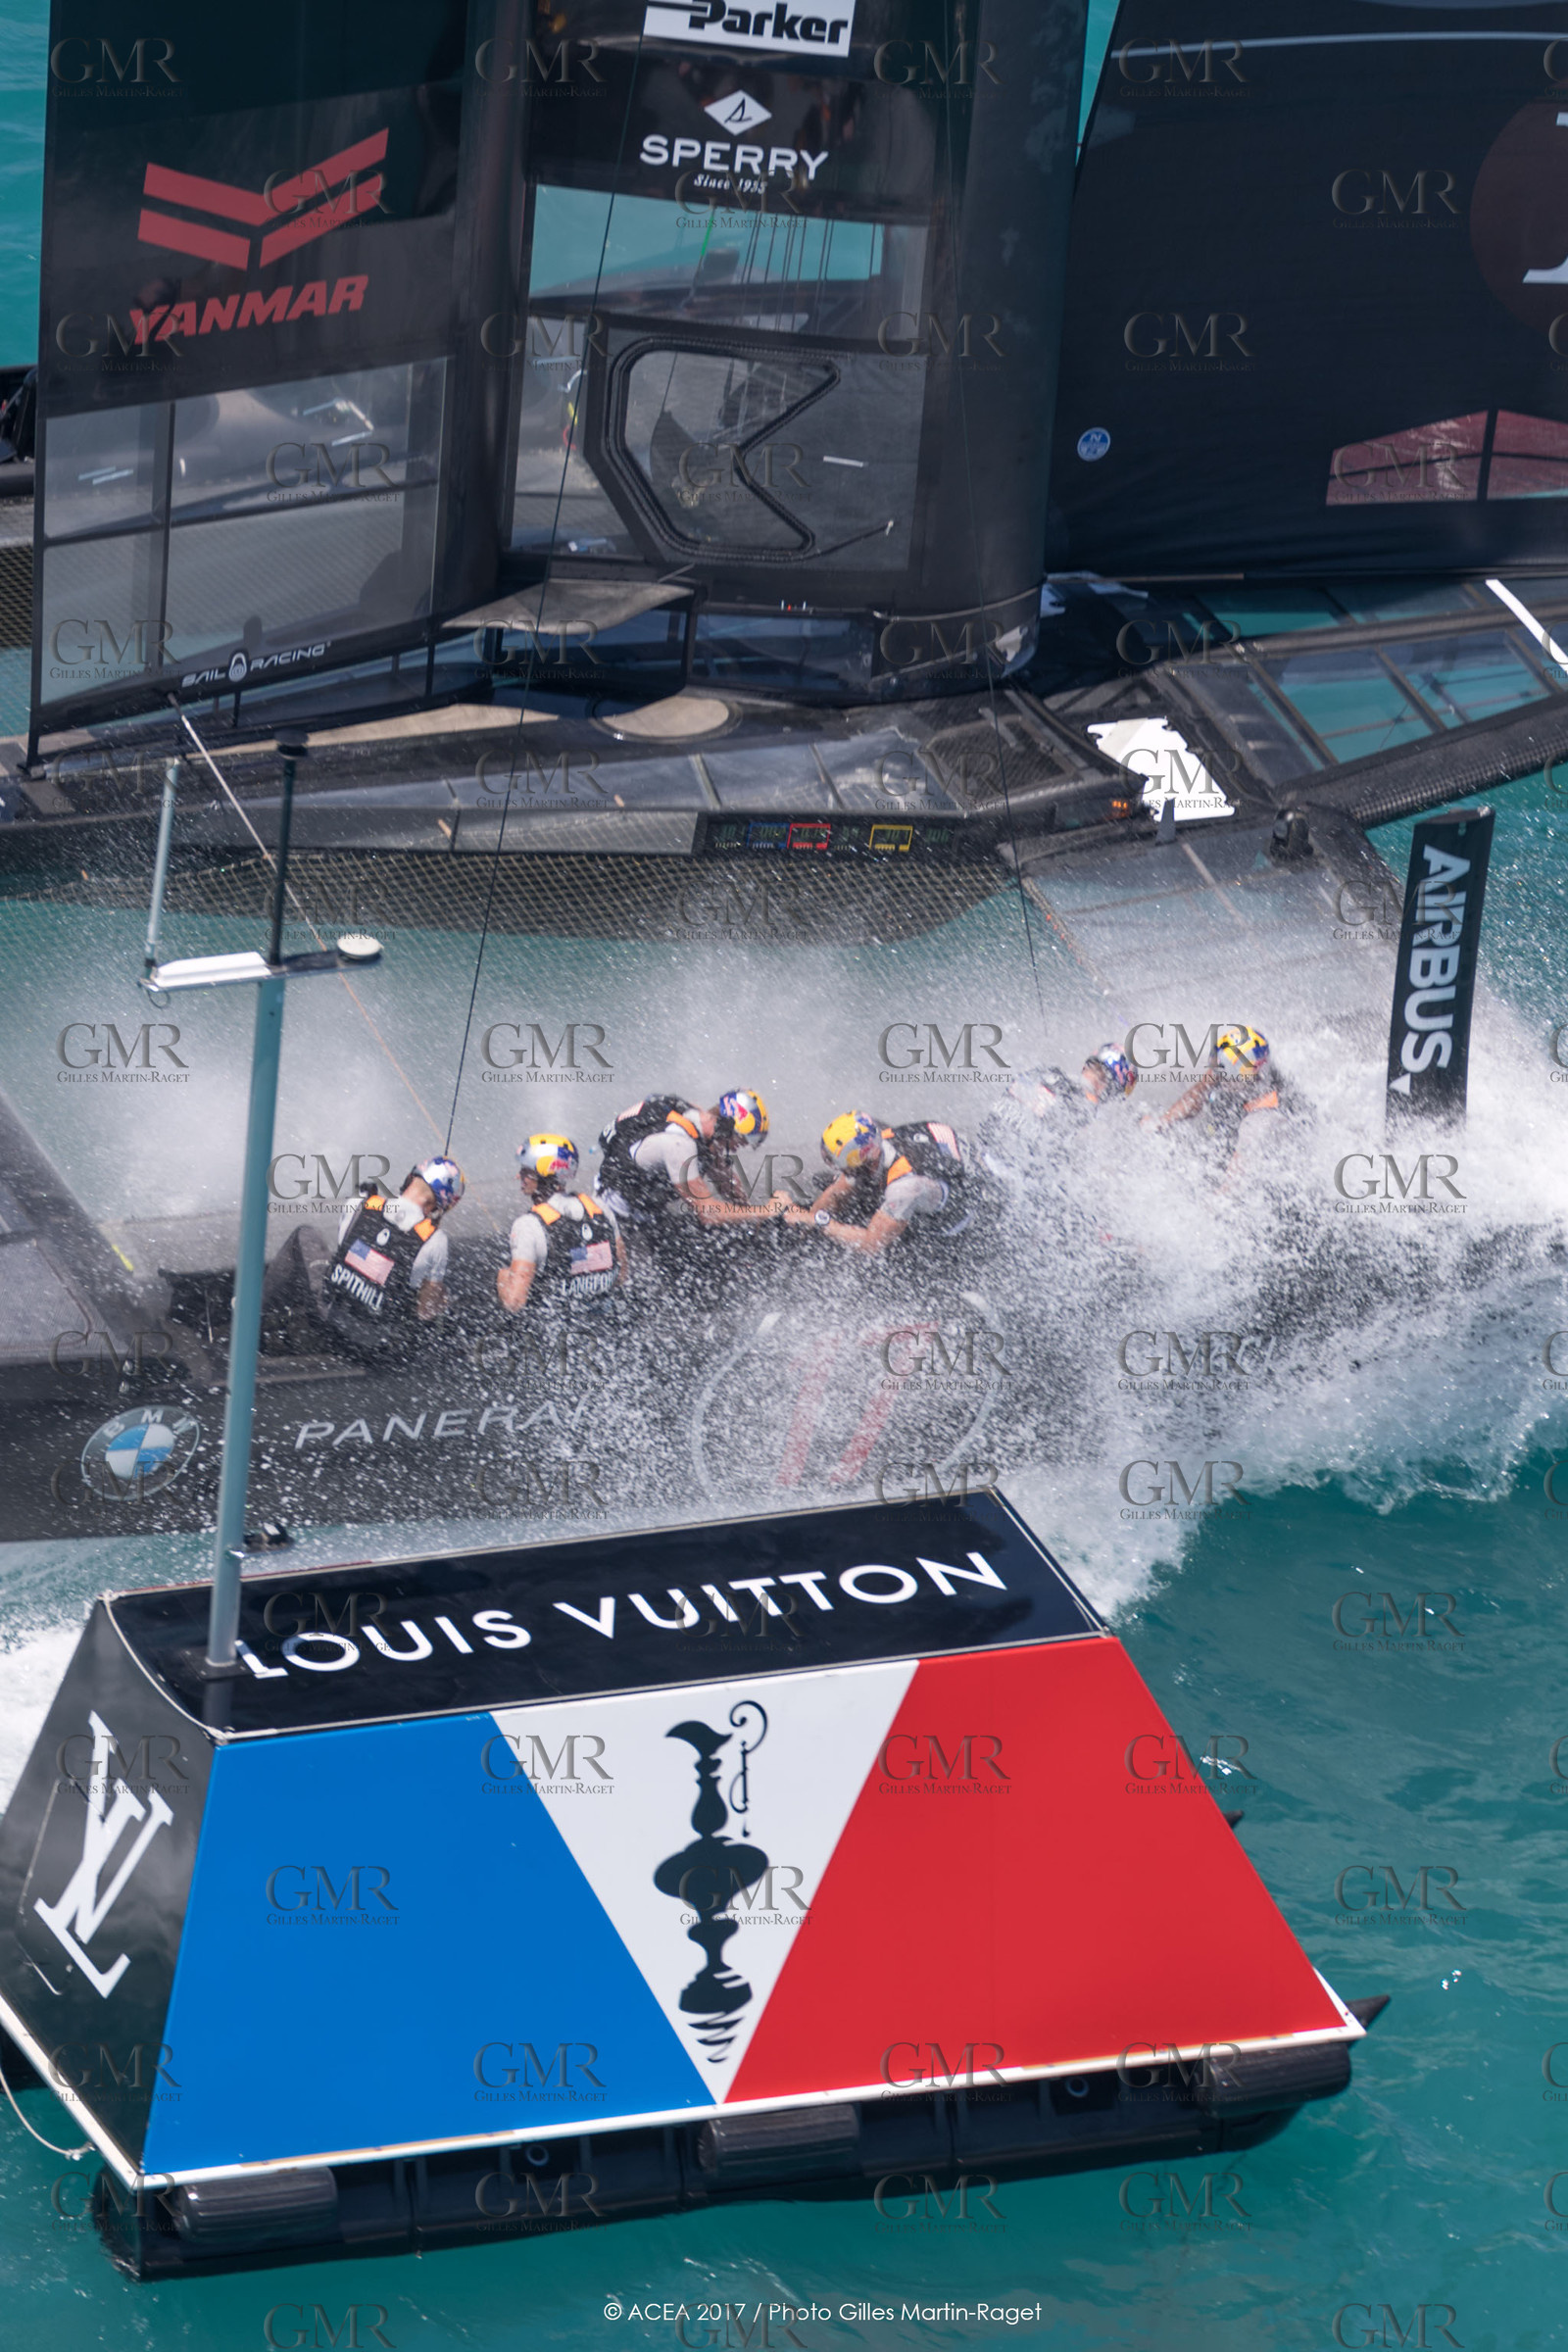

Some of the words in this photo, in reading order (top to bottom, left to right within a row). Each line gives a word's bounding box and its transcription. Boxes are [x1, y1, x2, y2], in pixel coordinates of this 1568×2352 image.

[647, 0, 849, 44] Parker
[640, 134, 829, 180] SPERRY
[693, 173, 731, 190] Since
[129, 275, 368, 345] YANMAR
[181, 668, 226, 688] SAIL
[1400, 844, 1471, 1074] AIRBUS
[295, 1395, 589, 1449] PANERAI
[233, 1609, 532, 1679] LOUIS
[553, 1551, 1008, 1640] VUITTON
